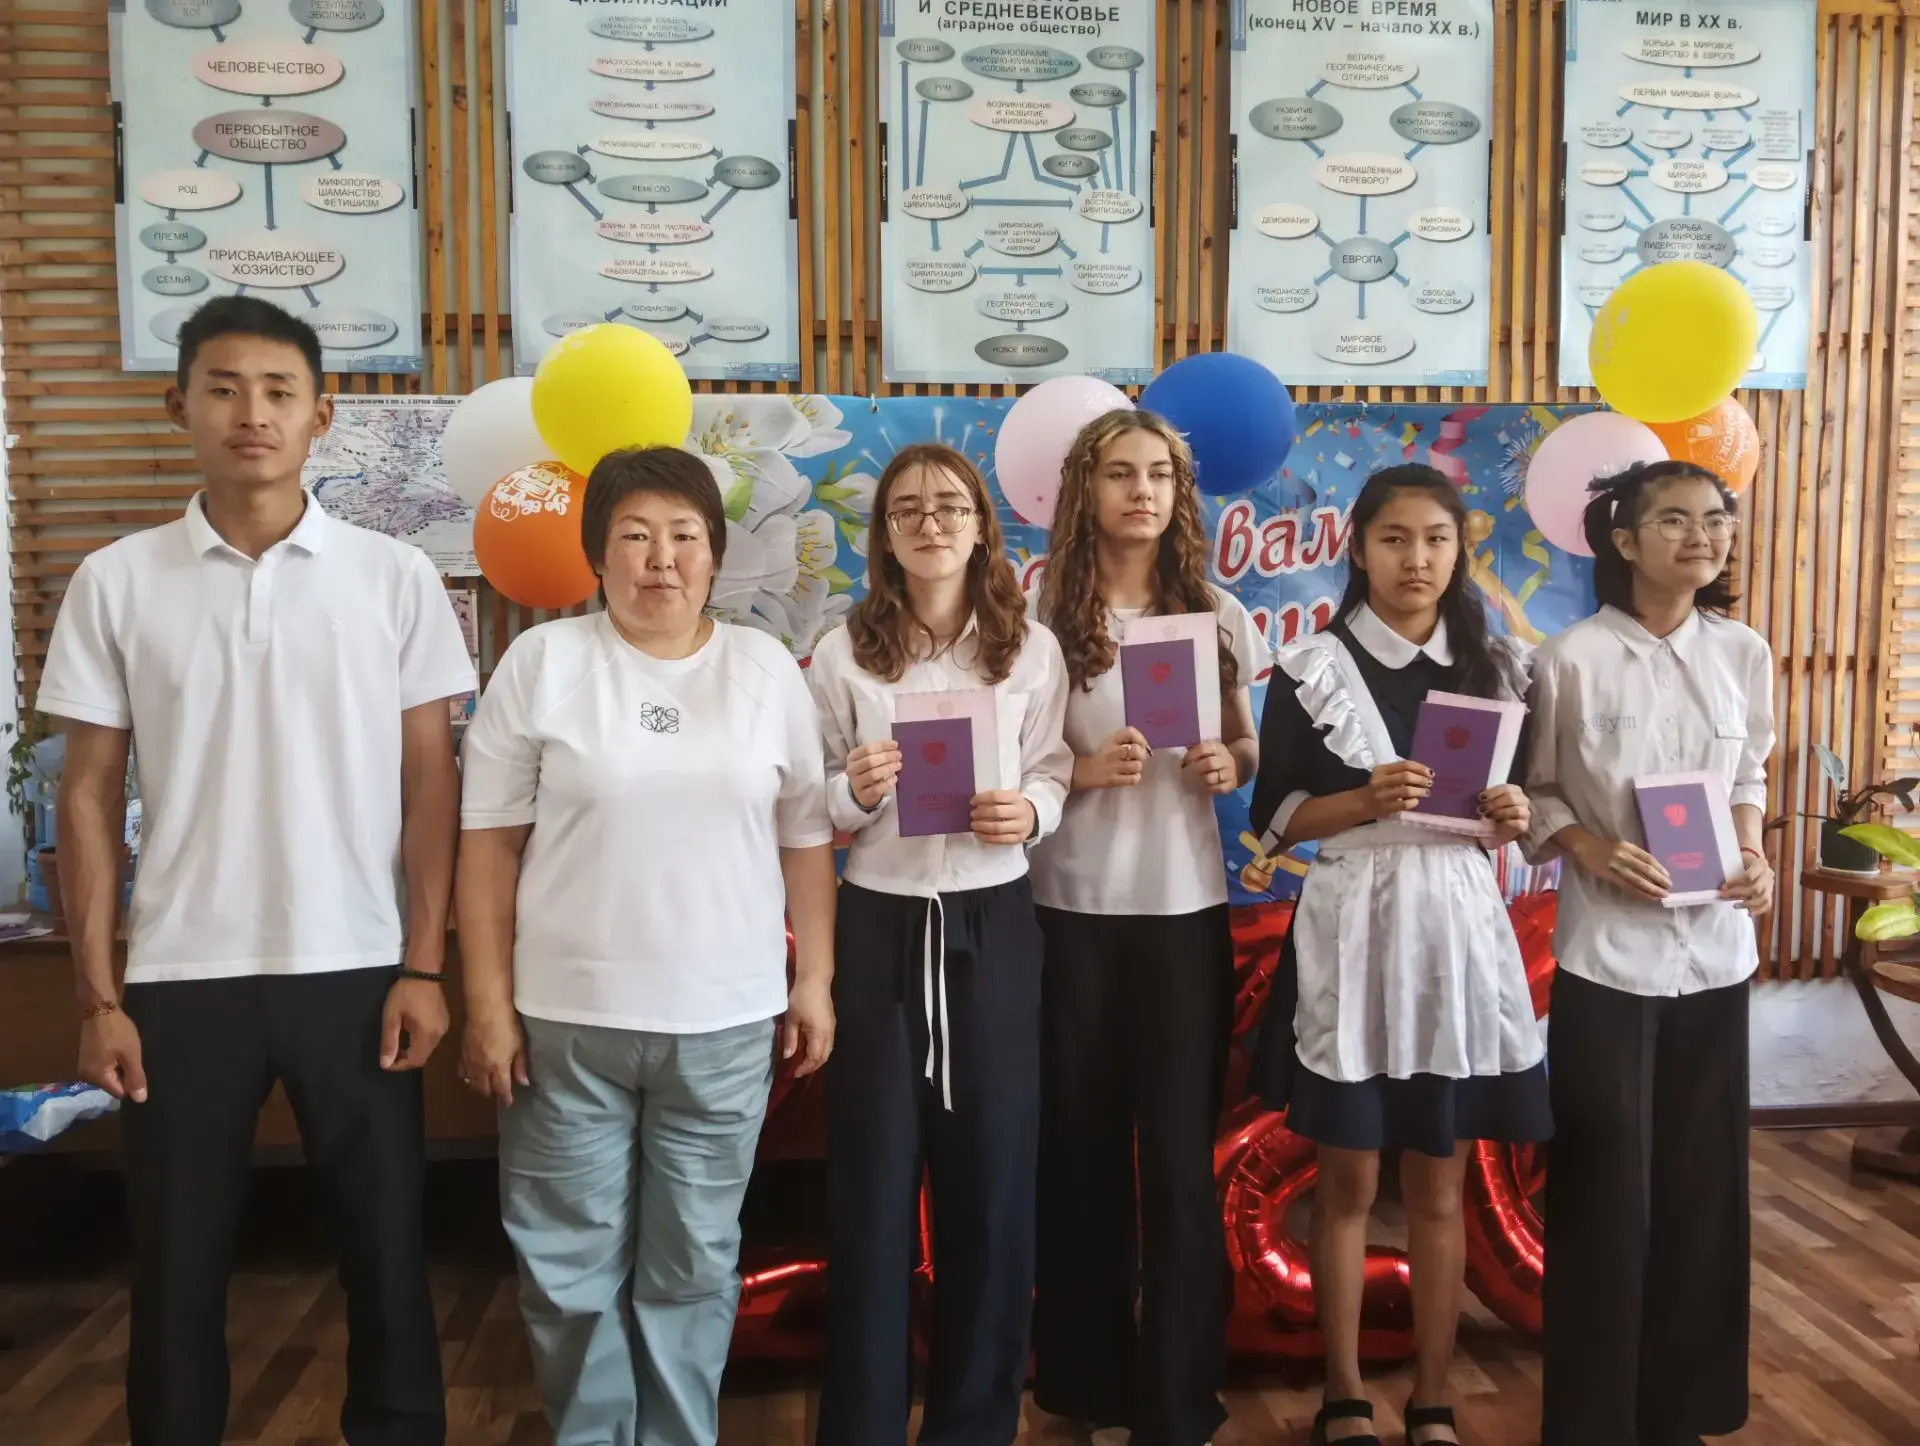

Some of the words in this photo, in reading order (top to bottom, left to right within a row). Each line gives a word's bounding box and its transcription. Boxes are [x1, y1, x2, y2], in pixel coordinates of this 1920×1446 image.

[919, 3, 930, 14] И
[945, 2, 1120, 21] СРЕДНЕВЕКОВЬЕ
[1293, 0, 1358, 14] НОВОЕ
[1372, 2, 1436, 17] ВРЕМЯ
[309, 11, 366, 20] ЭВОЛЮЦИИ
[1636, 11, 1672, 26] МИР
[1680, 14, 1690, 28] В
[1728, 18, 1742, 29] в.
[938, 16, 1014, 31] (аграрное
[1021, 20, 1101, 36] общество)
[1249, 16, 1306, 32] (конец
[1312, 17, 1336, 31] XV
[1361, 21, 1422, 34] начало
[1459, 23, 1480, 39] в.)
[909, 44, 940, 52] ГРЕЦИЯ
[1643, 39, 1675, 47] БОРЬБА
[1694, 41, 1734, 50] МИРОВОЕ
[990, 48, 1049, 57] РАЗНООБРАЗИЕ
[1100, 52, 1129, 60] ЕГИПЕТ
[1347, 53, 1385, 61] ВЕЛИКИЕ
[1641, 50, 1690, 59] ЛИДЕРСТВО
[1703, 52, 1735, 60] ЕВРОПЕ
[208, 61, 325, 75] ЧЕЛОВЕЧЕСТВО
[1326, 63, 1404, 73] ГЕОГРАФИЧЕСКИЕ
[1341, 73, 1389, 81] ОТКРЫТИЯ
[1634, 88, 1666, 96] ПЕРВАЯ
[1671, 89, 1710, 98] МИРОВАЯ
[1714, 91, 1741, 100] ВОЙНА
[987, 101, 1052, 110] ВОЗНИКНОВЕНИЕ
[215, 124, 319, 137] ПЕРВОБЫТНОЕ
[1069, 133, 1096, 142] ИНДИЯ
[229, 137, 307, 151] ОБЩЕСТВО
[1058, 160, 1082, 169] КИТАЙ
[1673, 162, 1704, 170] ВТОРАЯ
[1327, 165, 1402, 175] ПРОМЫШЛЕННЫЙ
[1339, 175, 1389, 185] ПЕРЕВОРОТ
[1668, 172, 1707, 180] МИРОВАЯ
[632, 185, 671, 193] РЕМЕСЛО
[1674, 180, 1702, 189] ВОЙНА
[178, 185, 197, 194] РОД
[912, 193, 953, 201] АНТИЧНЫЕ
[324, 199, 379, 208] ФЕТИШИЗМ
[904, 201, 961, 210] ЦИВИЛИЗАЦИИ
[1080, 206, 1135, 215] ЦИВИЛИЗАЦИИ
[1262, 216, 1310, 224] ДЕМОКРАТИЯ
[1670, 224, 1702, 232] БОРЬБА
[154, 232, 188, 240] ПЛЕМЯ
[1644, 241, 1693, 250] ЛИДЕРСТВО
[209, 250, 335, 264] ПРИСВАИВАЮЩЕЕ
[1342, 254, 1382, 264] ЕВРОПА
[232, 264, 315, 275] ХОЗЯЙСТВО
[911, 270, 963, 278] ЦИВИЛИЗАЦИЯ
[1257, 288, 1310, 296] ГРАЖДАНСКОЕ
[1264, 296, 1304, 304] ОБЩЕСТВО
[1417, 297, 1463, 305] ТВОРЧЕСТВА
[1000, 308, 1041, 316] ОТКРЫТИЯ
[313, 324, 386, 332] БИРАТЕЛЬСТВО
[1340, 335, 1382, 344] МИРОВОЕ
[1336, 344, 1387, 354] ЛИДЕРСТВО
[1218, 505, 1353, 578] вам
